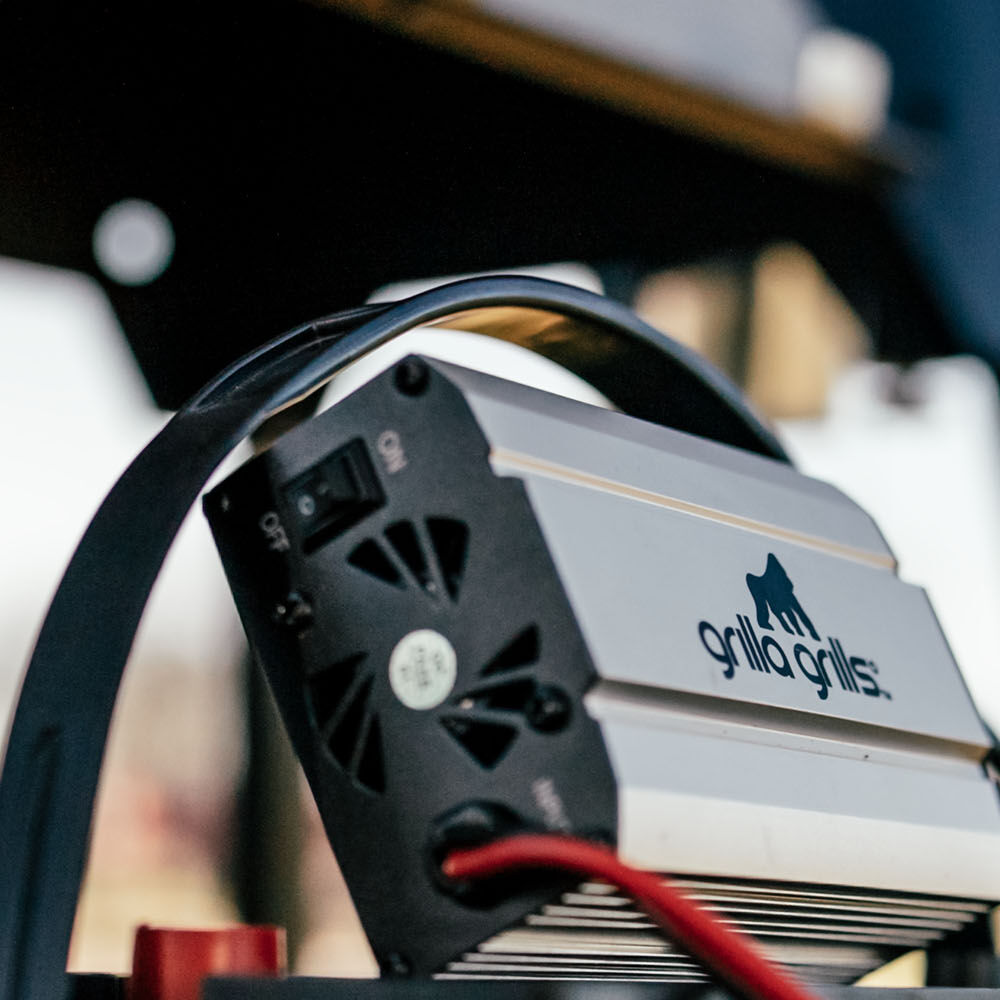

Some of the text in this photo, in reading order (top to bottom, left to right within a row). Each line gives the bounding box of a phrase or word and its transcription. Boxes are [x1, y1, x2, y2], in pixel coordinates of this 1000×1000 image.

[378, 430, 408, 474] ON
[258, 511, 290, 551] OFF
[698, 613, 879, 700] grilla grills
